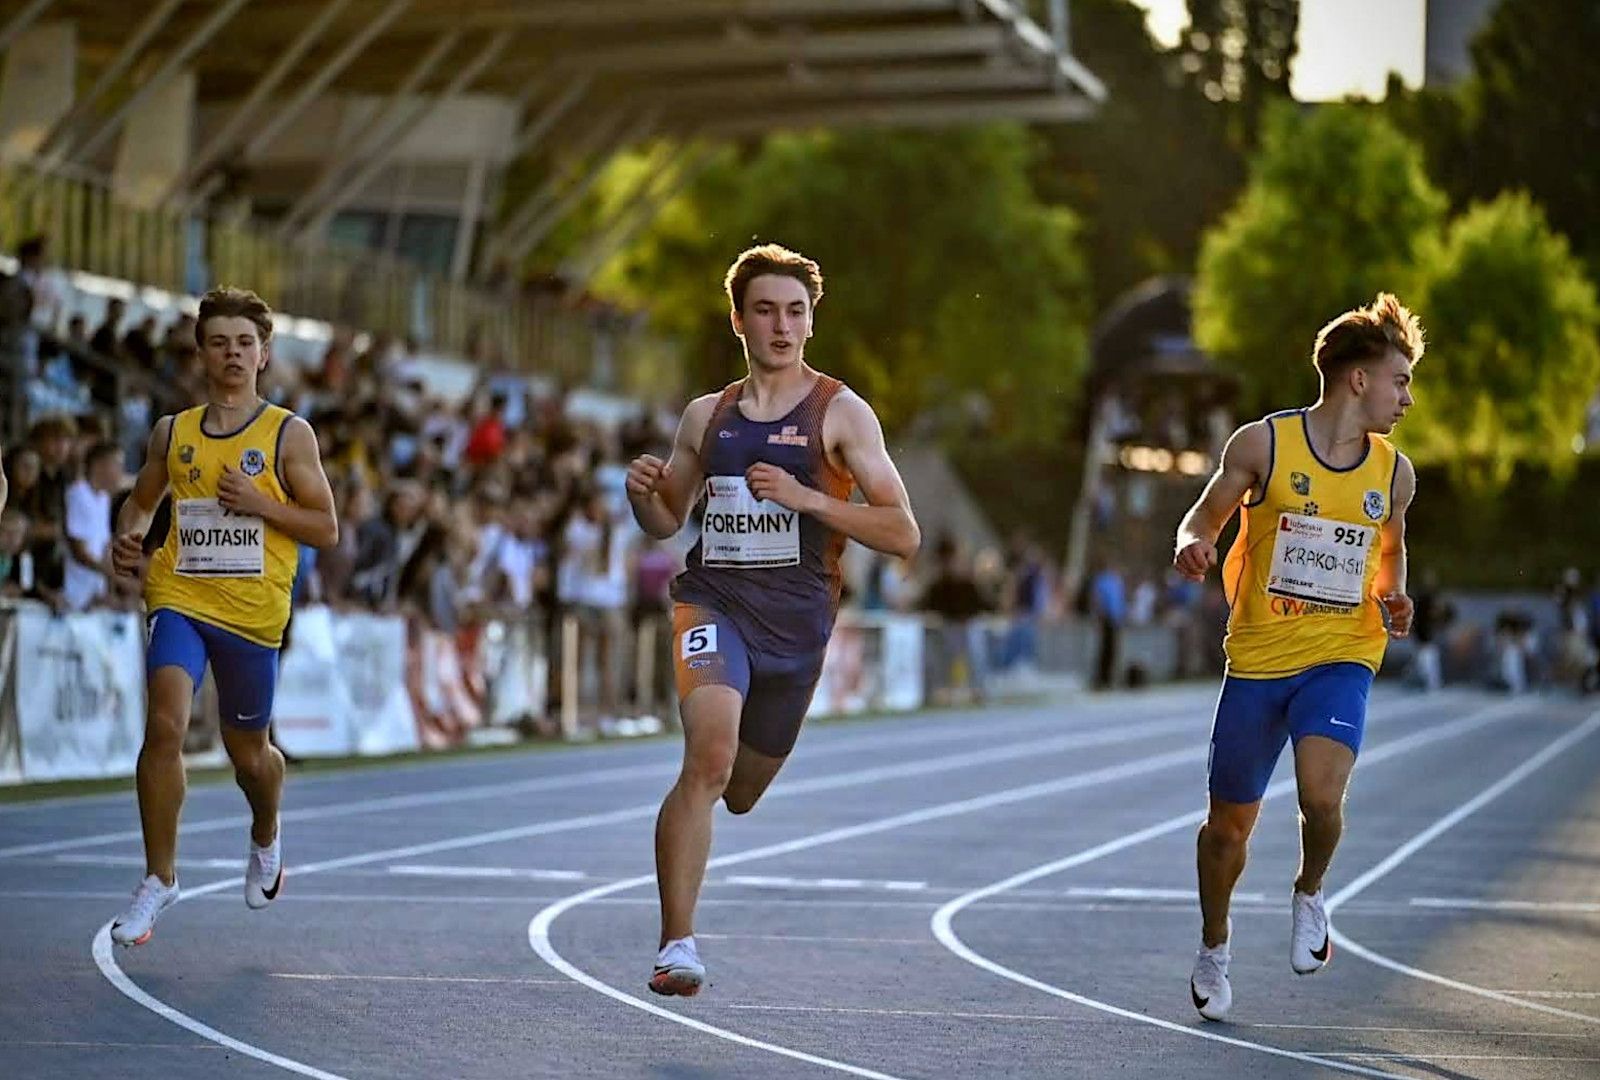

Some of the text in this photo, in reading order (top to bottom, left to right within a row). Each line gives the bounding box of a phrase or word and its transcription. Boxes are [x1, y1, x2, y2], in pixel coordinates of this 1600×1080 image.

[705, 513, 794, 533] FOREMNY
[180, 528, 259, 546] WOJTASIK
[1334, 527, 1365, 547] 951
[688, 627, 708, 652] 5
